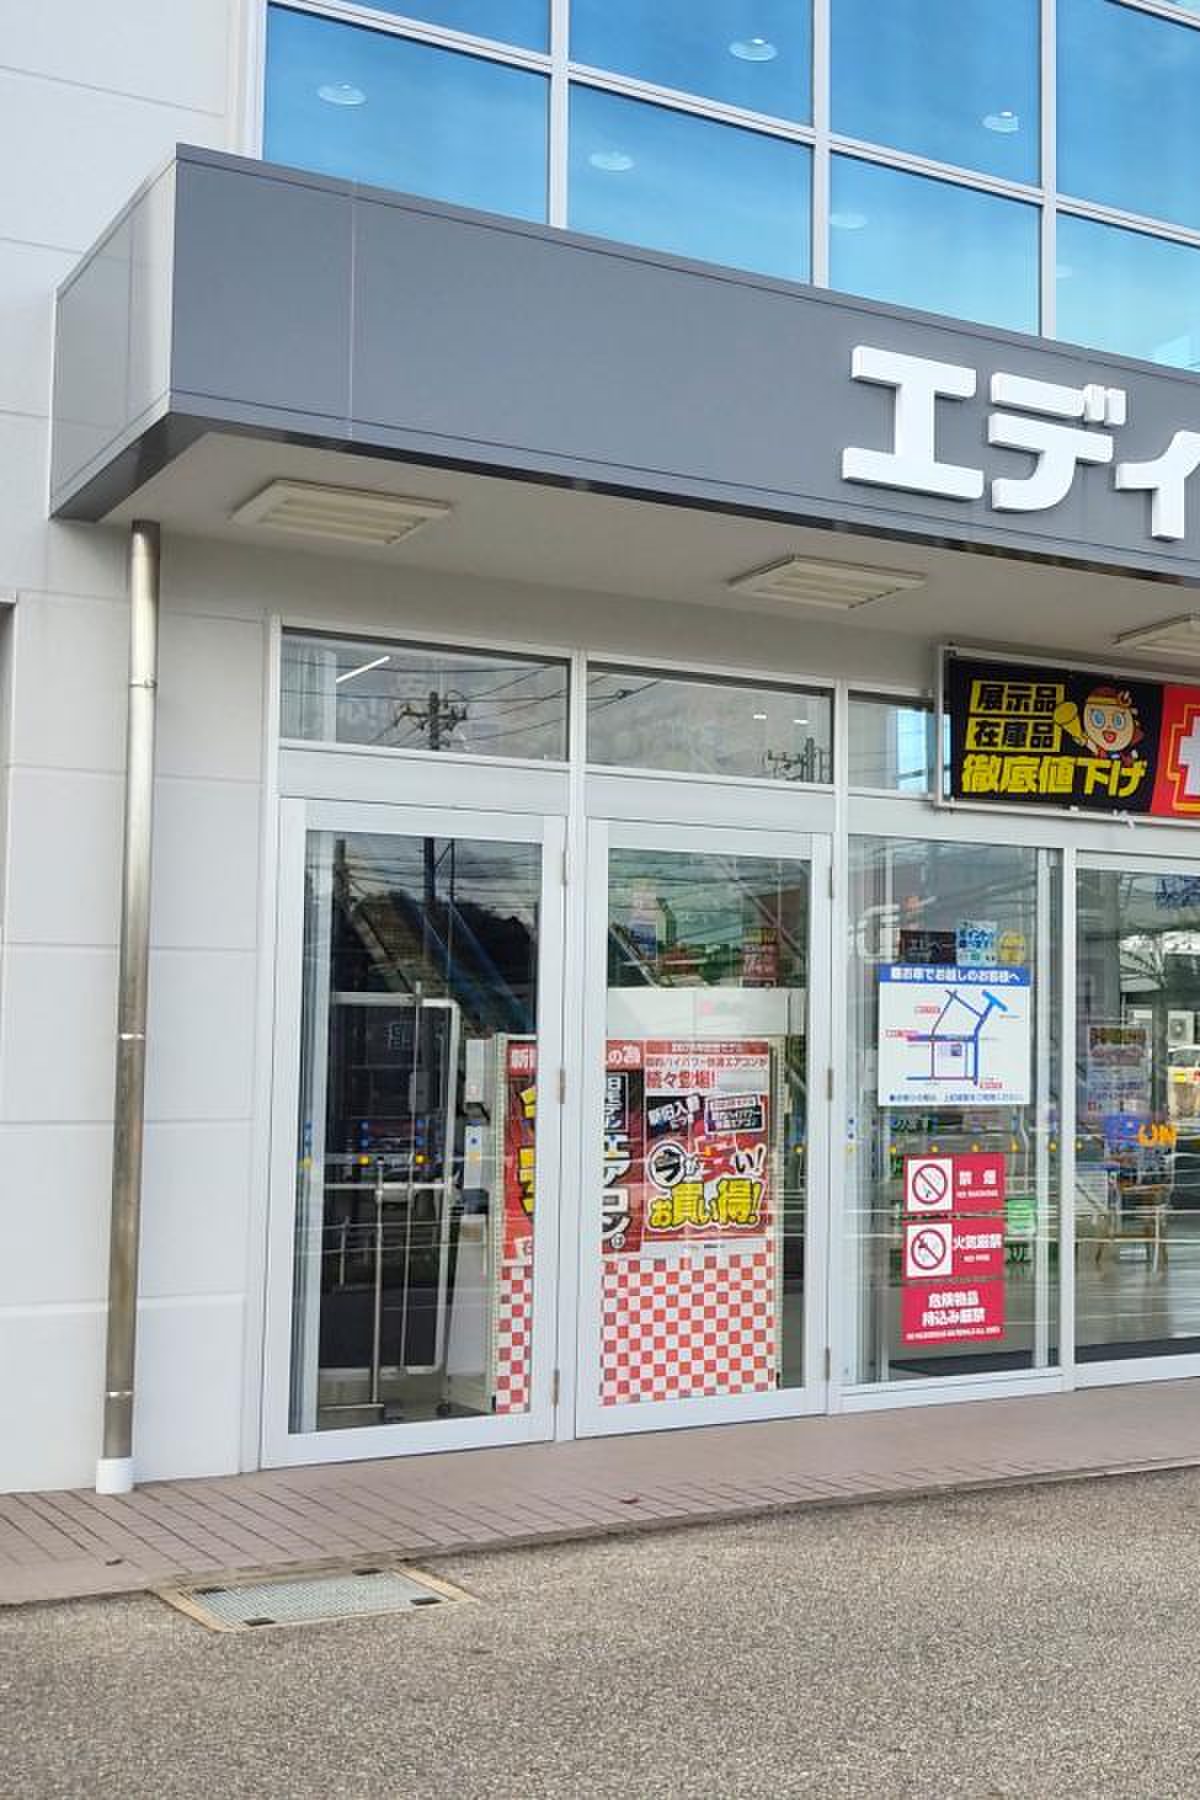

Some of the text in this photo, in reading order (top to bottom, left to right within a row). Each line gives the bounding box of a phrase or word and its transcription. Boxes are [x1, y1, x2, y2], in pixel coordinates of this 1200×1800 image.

[976, 682, 1060, 715] 展示品
[973, 718, 1057, 752] 在庫品
[961, 754, 1149, 799] 徹底値下げ
